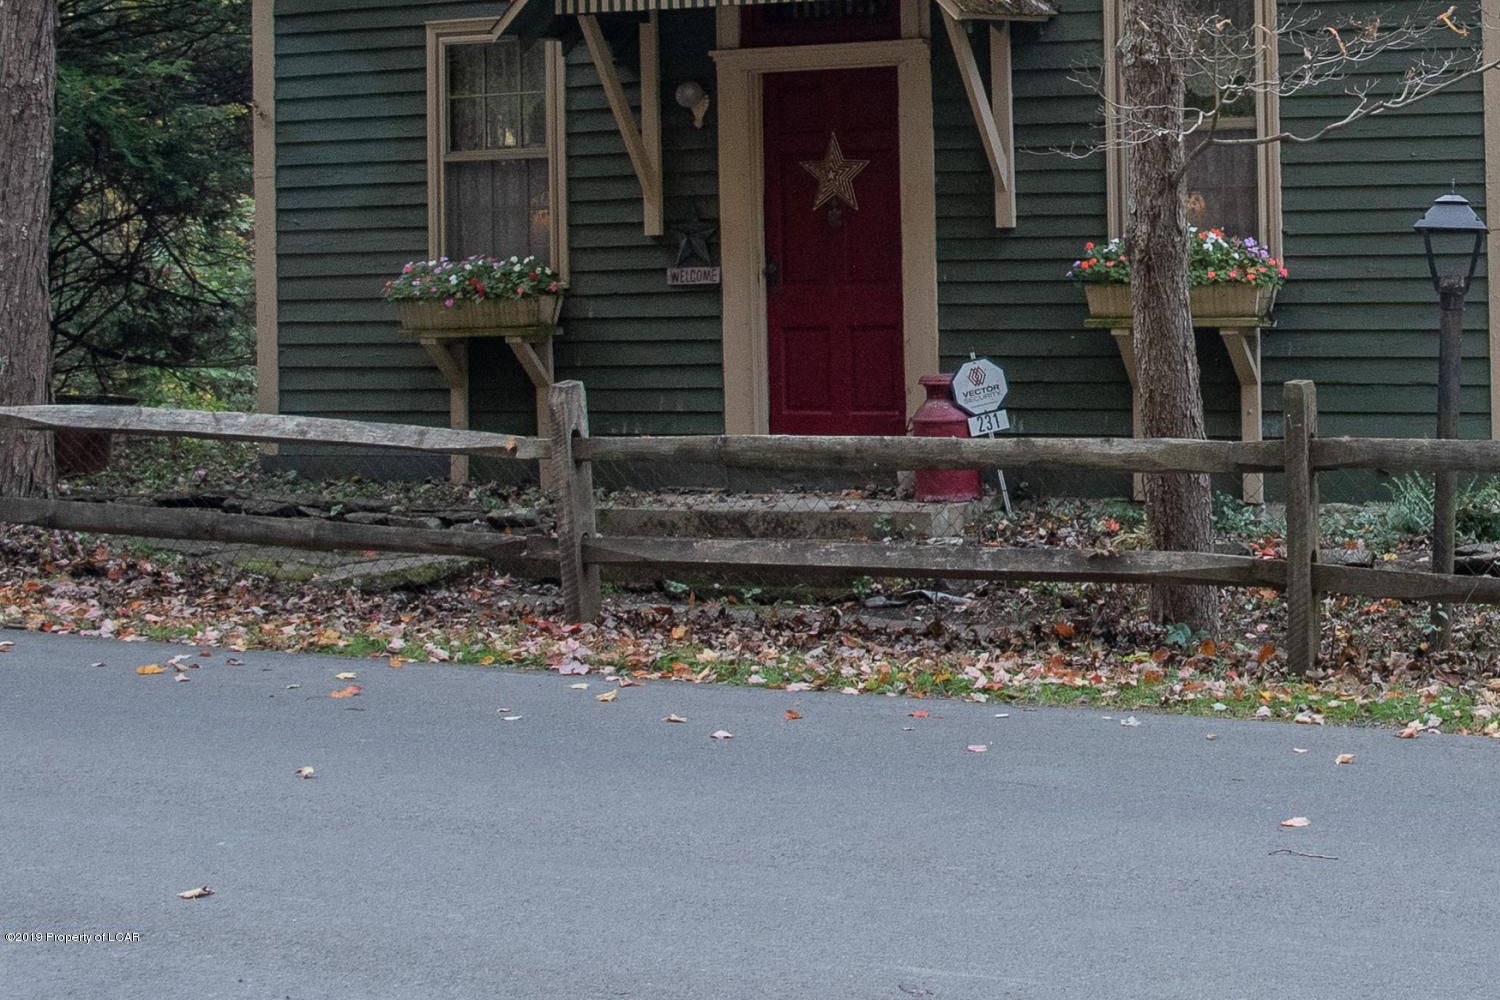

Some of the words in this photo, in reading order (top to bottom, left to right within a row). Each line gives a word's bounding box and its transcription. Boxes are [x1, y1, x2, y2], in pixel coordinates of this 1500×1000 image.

[670, 269, 718, 283] WELCOME
[962, 384, 1000, 398] VECTOR
[976, 413, 1000, 432] 231
